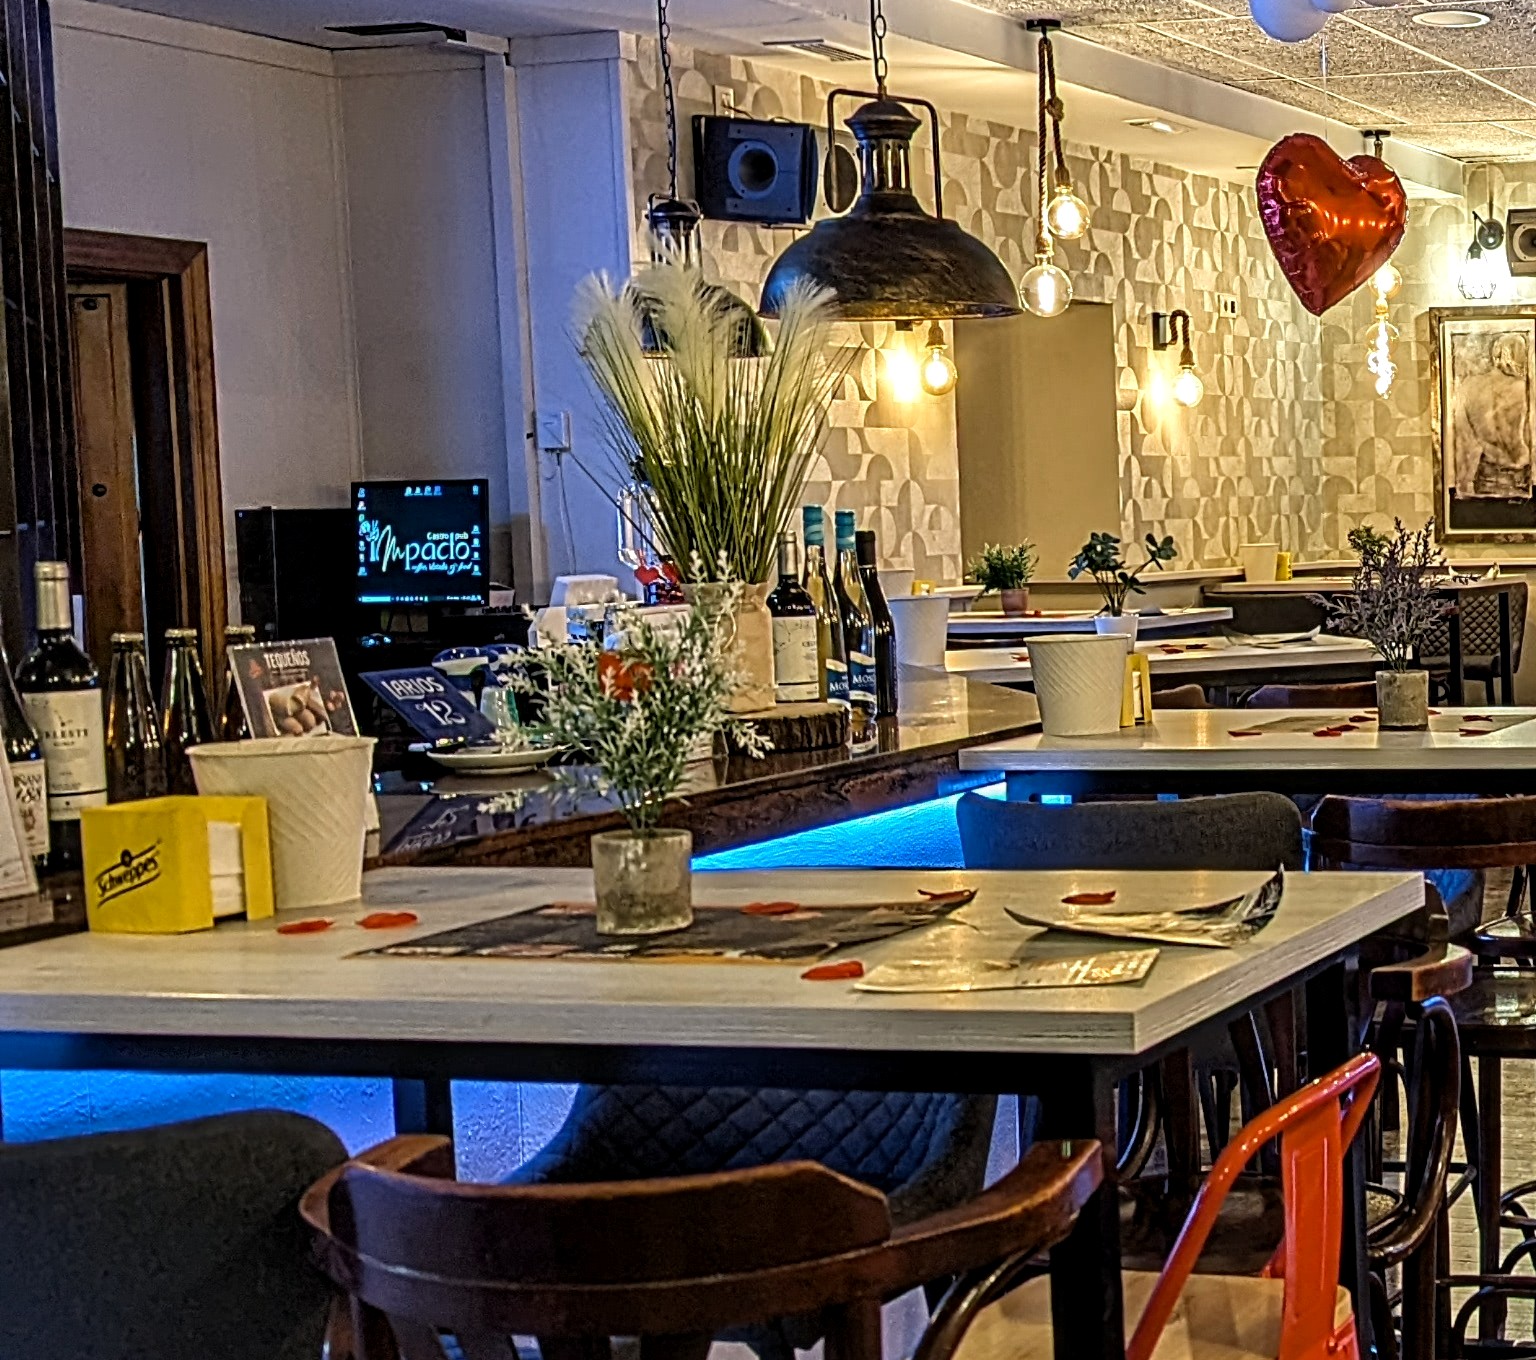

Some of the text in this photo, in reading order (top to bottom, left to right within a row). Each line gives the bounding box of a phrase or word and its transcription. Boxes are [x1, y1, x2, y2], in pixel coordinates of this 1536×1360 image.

[263, 648, 311, 670] TEQUEÑOS
[380, 676, 445, 701] LARIOS
[96, 849, 161, 899] Schweppes
